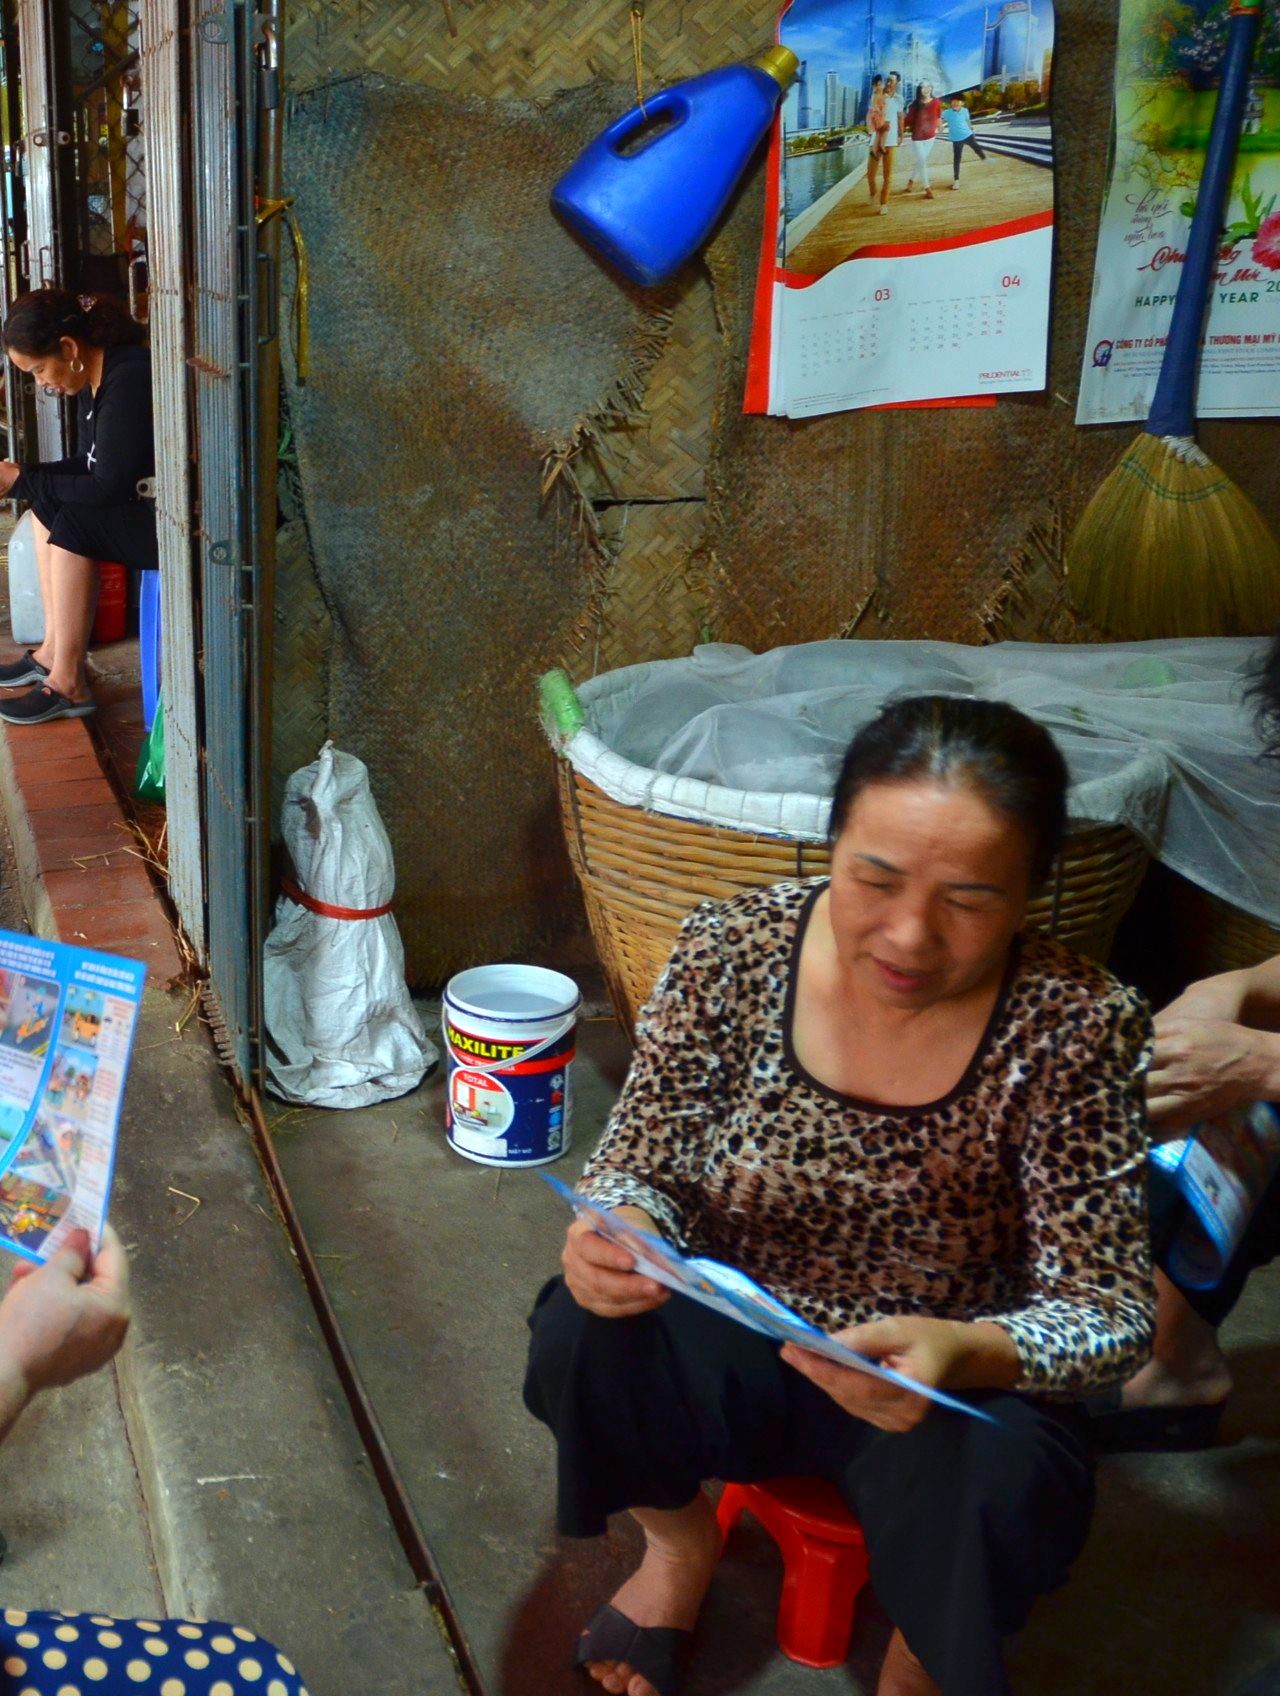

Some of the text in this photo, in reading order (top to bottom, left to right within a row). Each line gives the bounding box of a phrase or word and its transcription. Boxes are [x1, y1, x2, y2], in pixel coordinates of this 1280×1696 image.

[1002, 275, 1020, 288] 04
[875, 288, 890, 301] 03
[1135, 294, 1176, 307] HAPPY
[1220, 291, 1260, 303] YEAR
[979, 370, 1020, 379] PRUDENTIAL
[448, 1025, 524, 1060] MAXILITE
[463, 1073, 489, 1088] TOTAL
